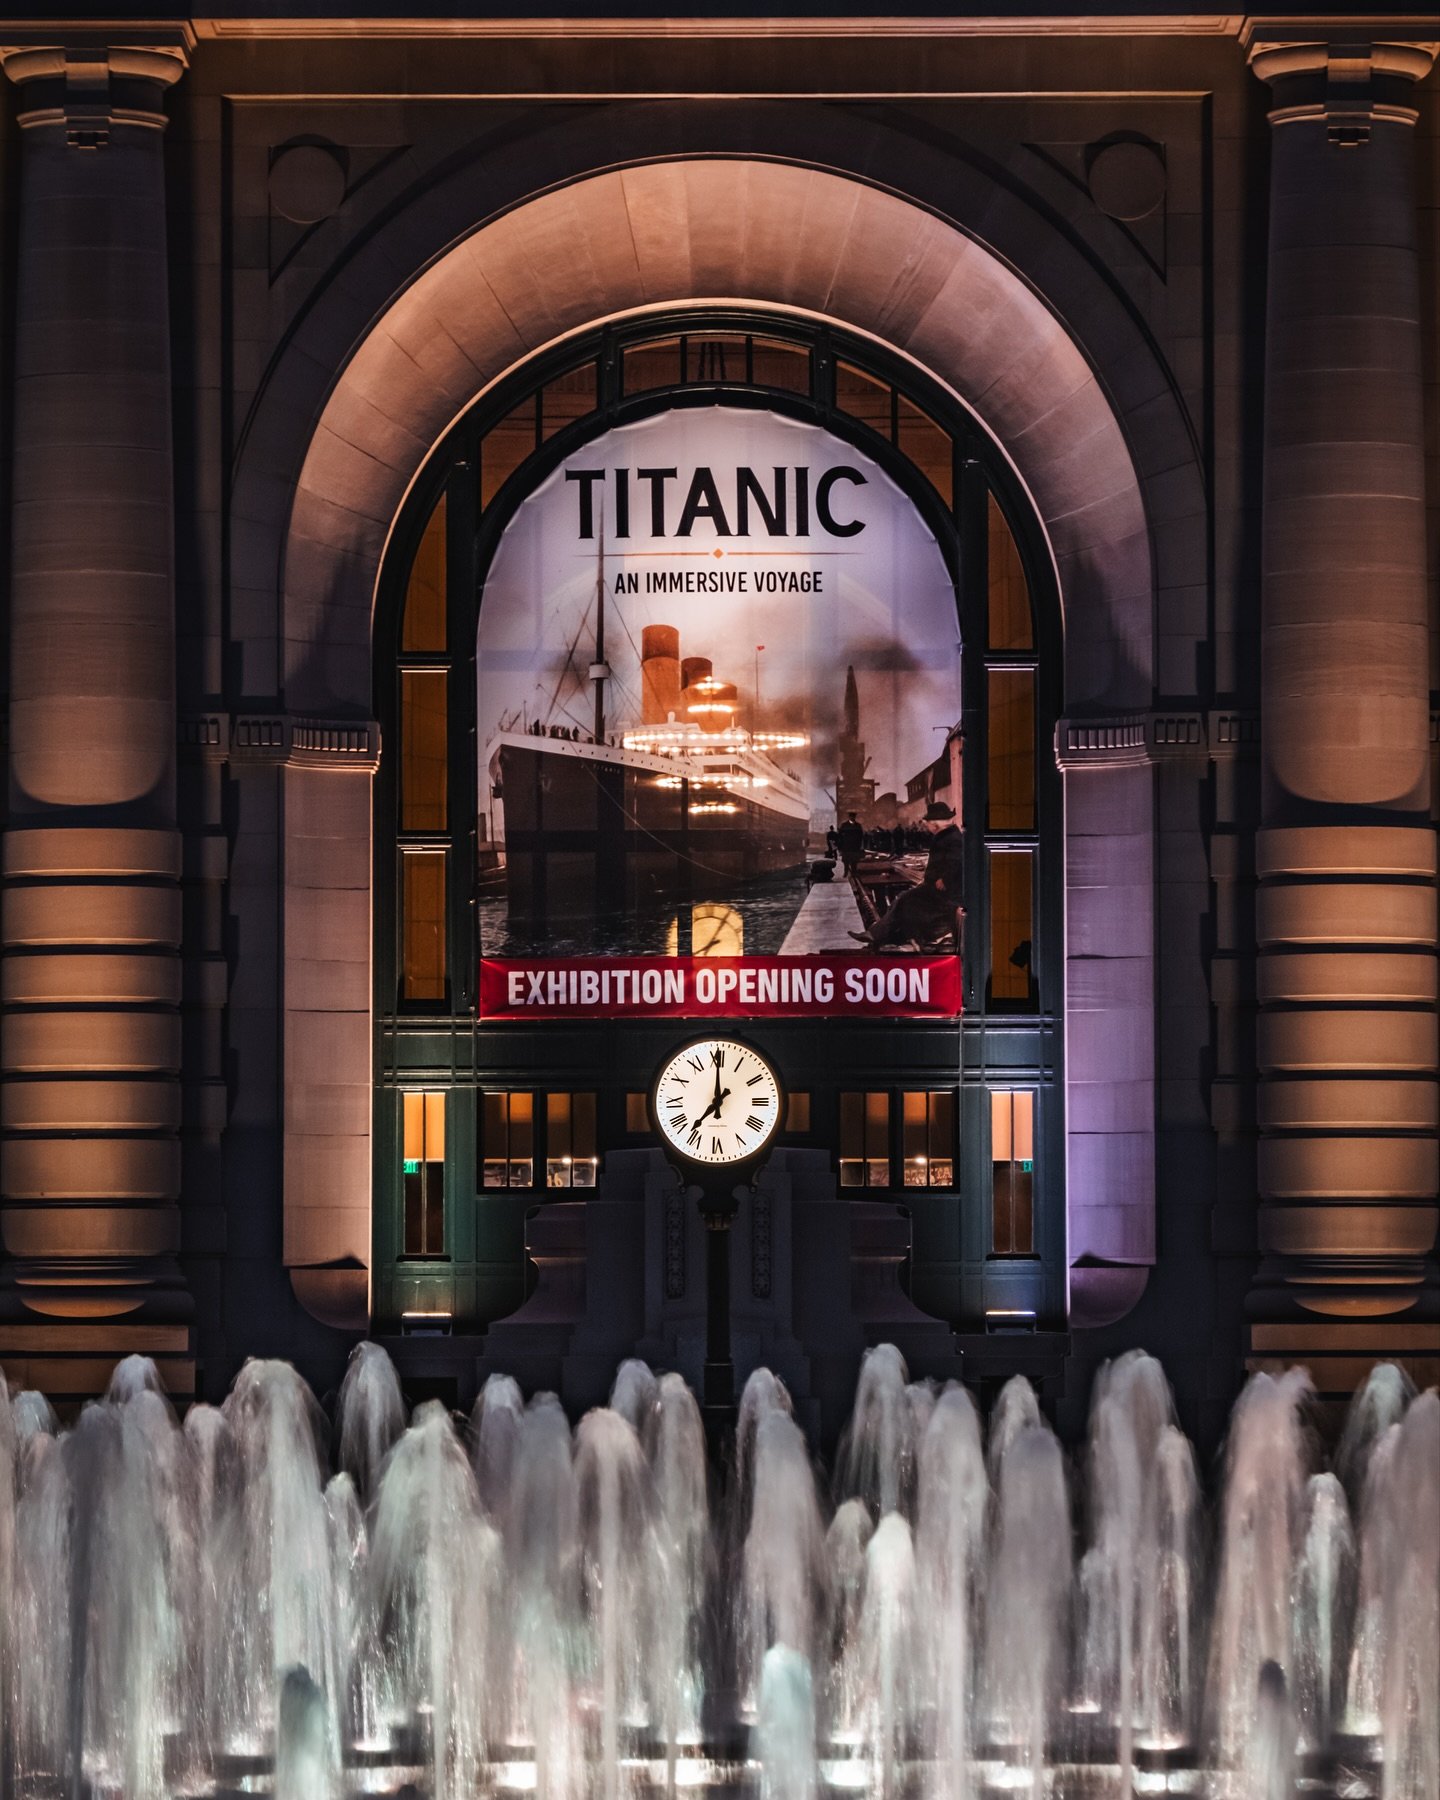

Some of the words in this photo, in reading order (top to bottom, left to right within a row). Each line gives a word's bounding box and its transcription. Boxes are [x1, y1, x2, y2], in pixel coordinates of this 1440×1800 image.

[565, 465, 869, 539] TITANIC
[614, 572, 639, 594] AN
[645, 571, 748, 594] IMMERSIVE
[754, 571, 824, 593] VOYAGE
[507, 969, 685, 1006] EXHIBITION
[695, 968, 834, 1004] OPENING
[844, 967, 930, 1004] SOON
